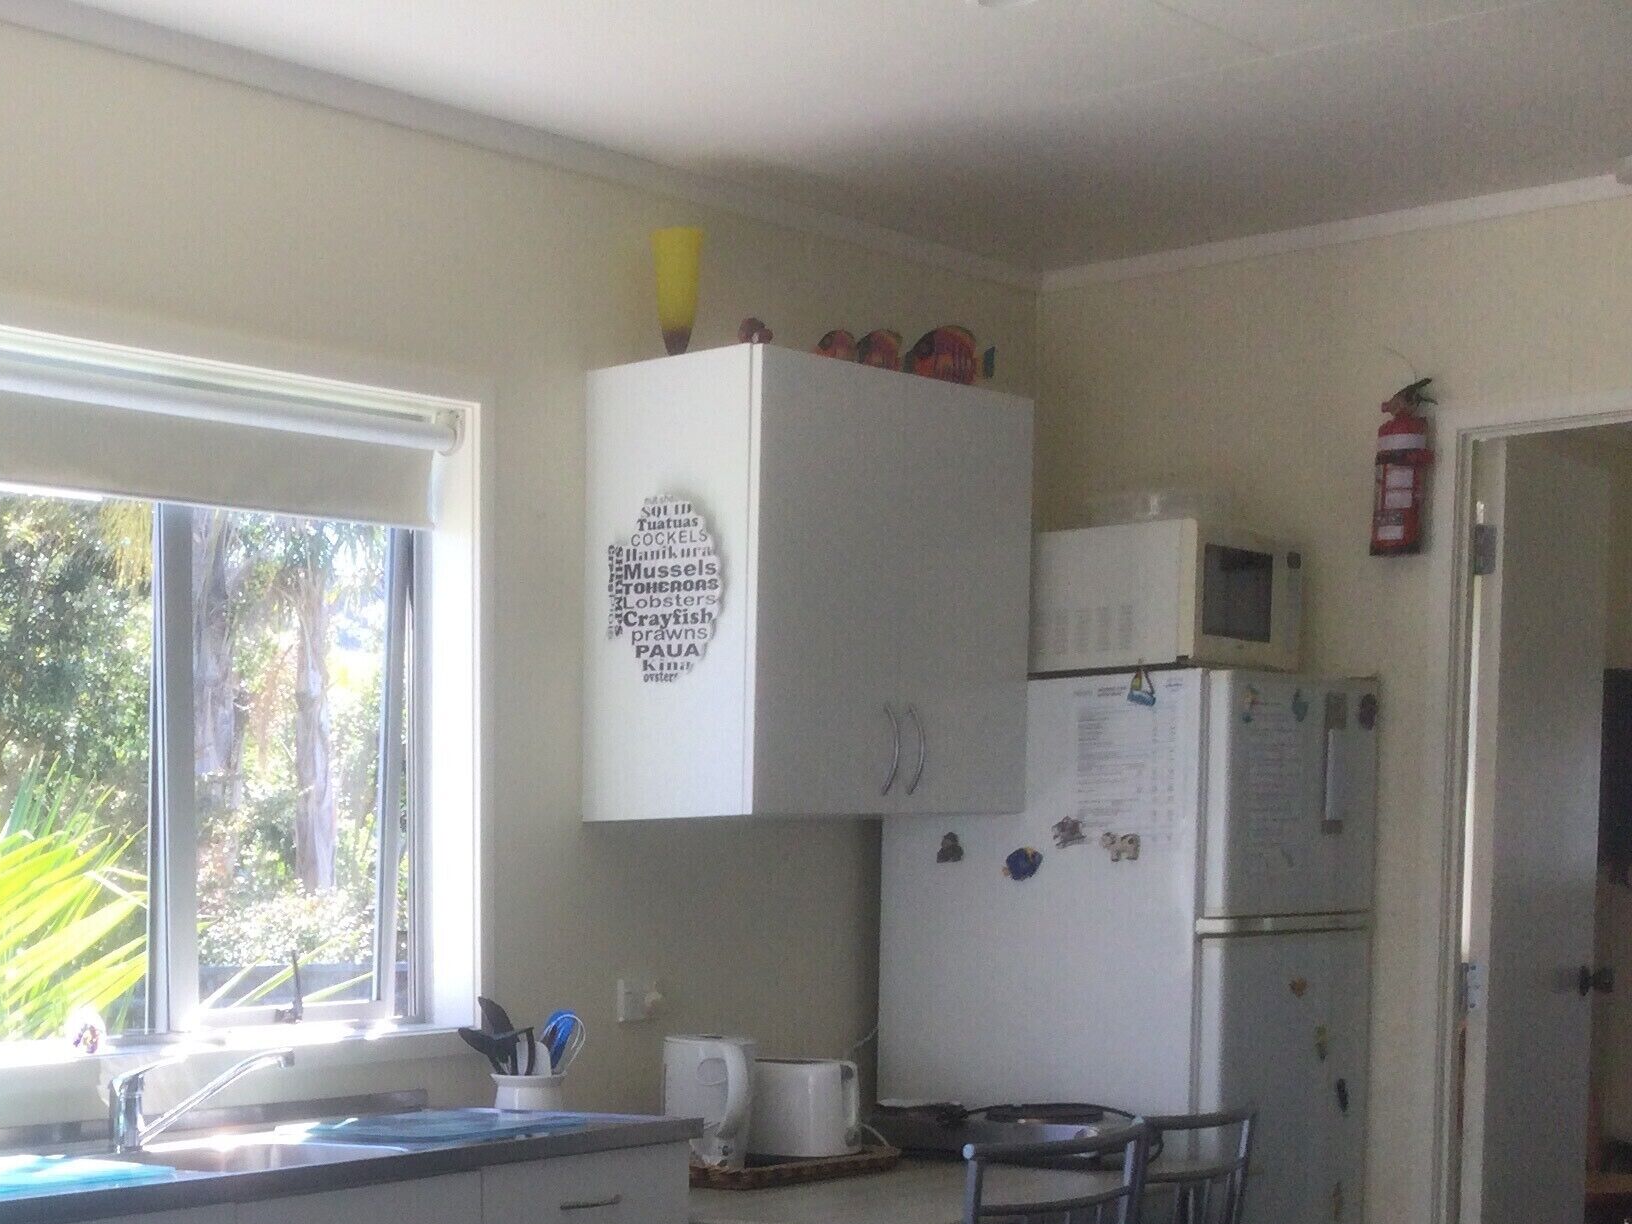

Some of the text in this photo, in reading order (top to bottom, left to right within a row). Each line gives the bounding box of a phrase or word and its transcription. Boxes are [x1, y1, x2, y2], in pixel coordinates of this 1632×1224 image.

[637, 517, 699, 532] Tuatuas
[631, 529, 708, 547] COCKELS
[623, 559, 717, 580] Mussels
[623, 593, 717, 610] Lobsters
[623, 607, 714, 629] Crayfish
[631, 627, 708, 645] prawns
[635, 643, 700, 659] PAUA
